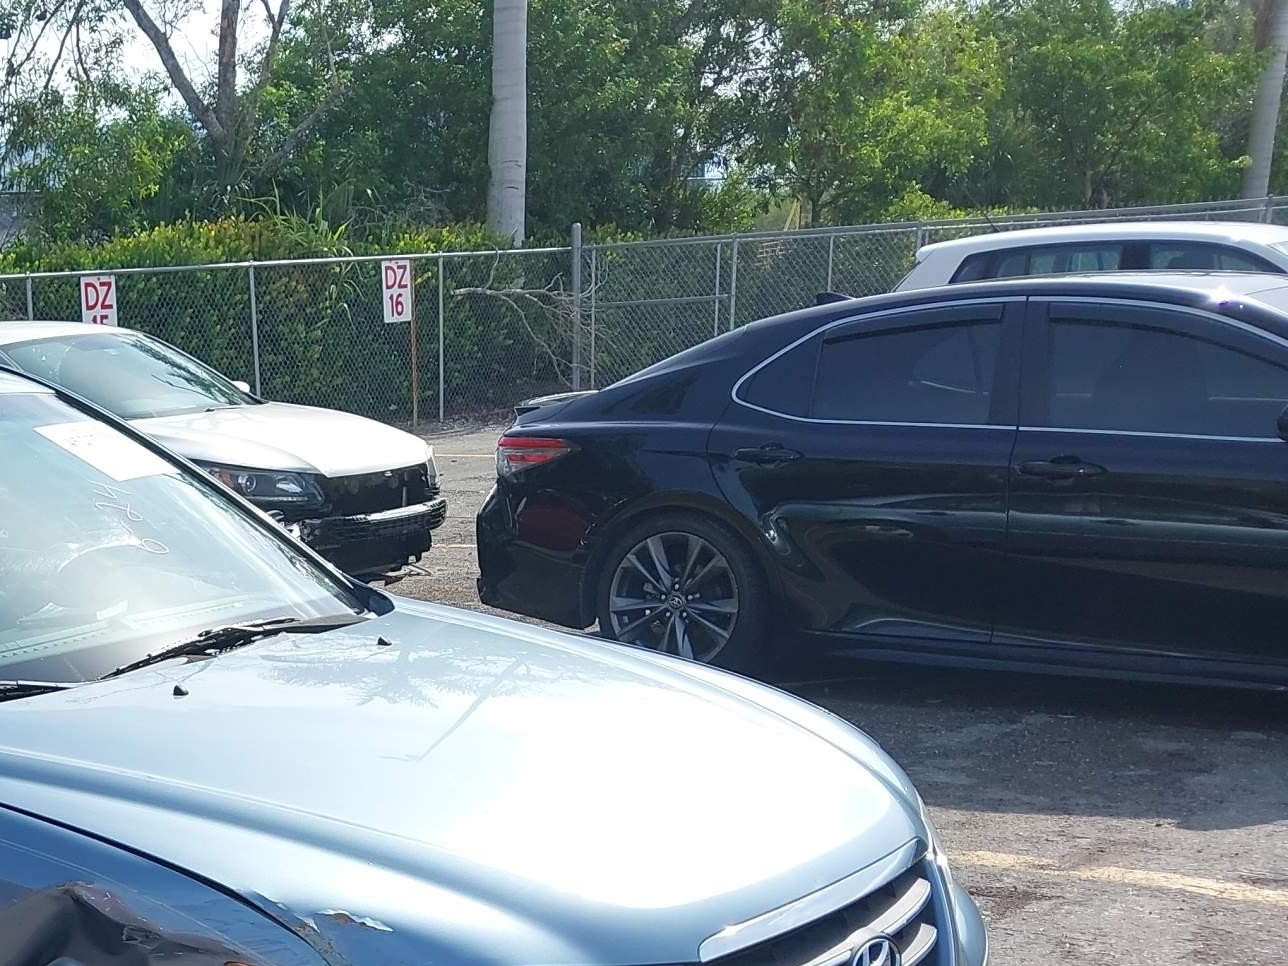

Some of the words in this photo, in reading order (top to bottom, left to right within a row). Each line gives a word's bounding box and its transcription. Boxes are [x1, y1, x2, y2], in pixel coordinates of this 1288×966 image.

[384, 264, 409, 290] DZ
[84, 281, 114, 311] DZ
[388, 292, 405, 318] 16
